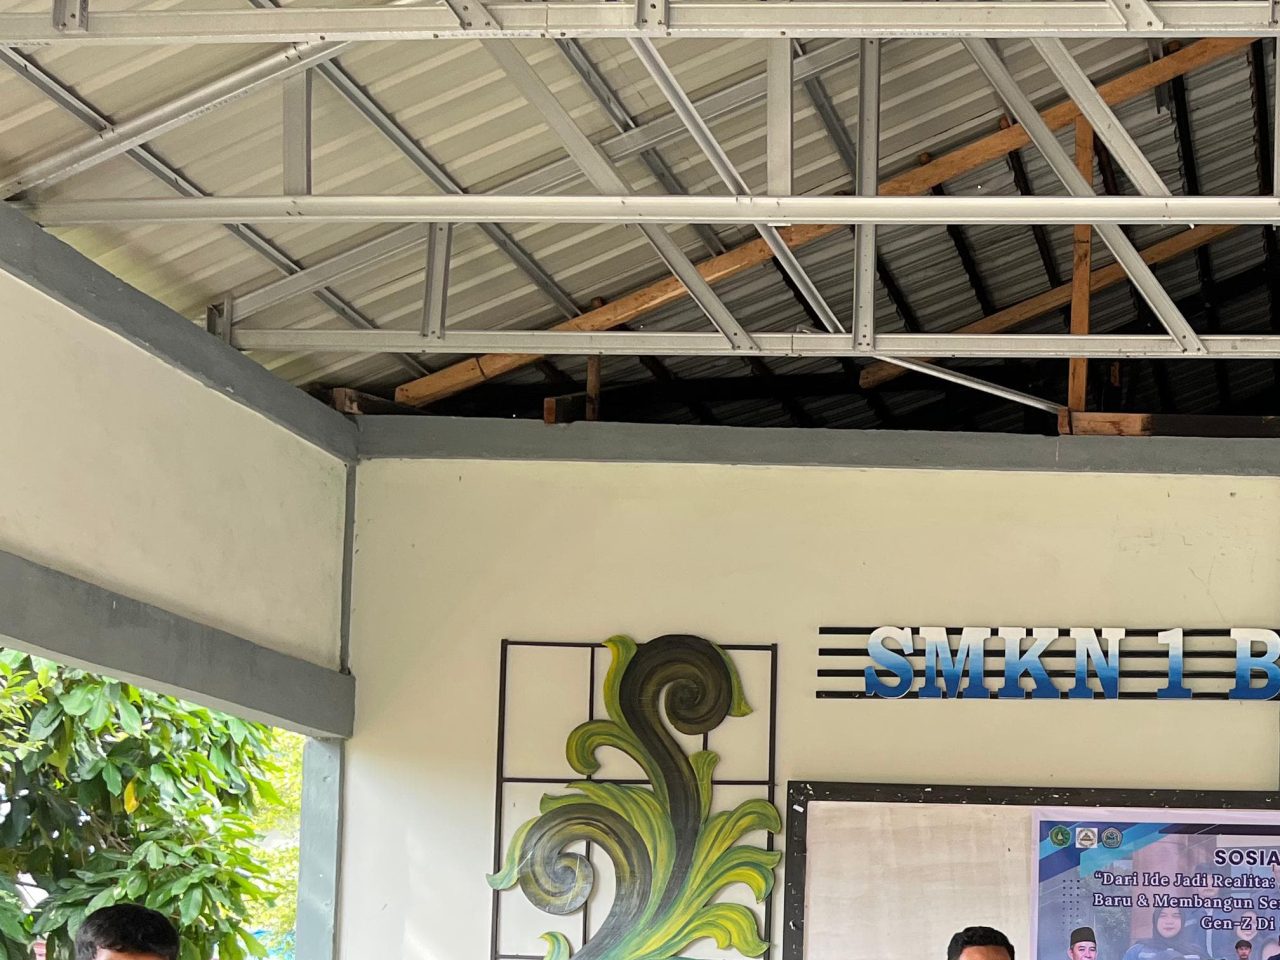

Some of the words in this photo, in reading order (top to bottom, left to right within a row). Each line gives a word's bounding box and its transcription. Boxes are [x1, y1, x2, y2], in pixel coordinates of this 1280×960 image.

[864, 625, 1127, 701] SMKN
[1156, 629, 1194, 702] 1
[1143, 873, 1170, 887] Ide
[1174, 873, 1208, 888] Jadi
[1212, 874, 1276, 889] Realita:
[1093, 893, 1132, 907] Baru
[1137, 894, 1149, 907] &
[1153, 895, 1254, 911] Membangun
[1200, 916, 1252, 930] Gen-Z
[1256, 916, 1276, 931] Di
